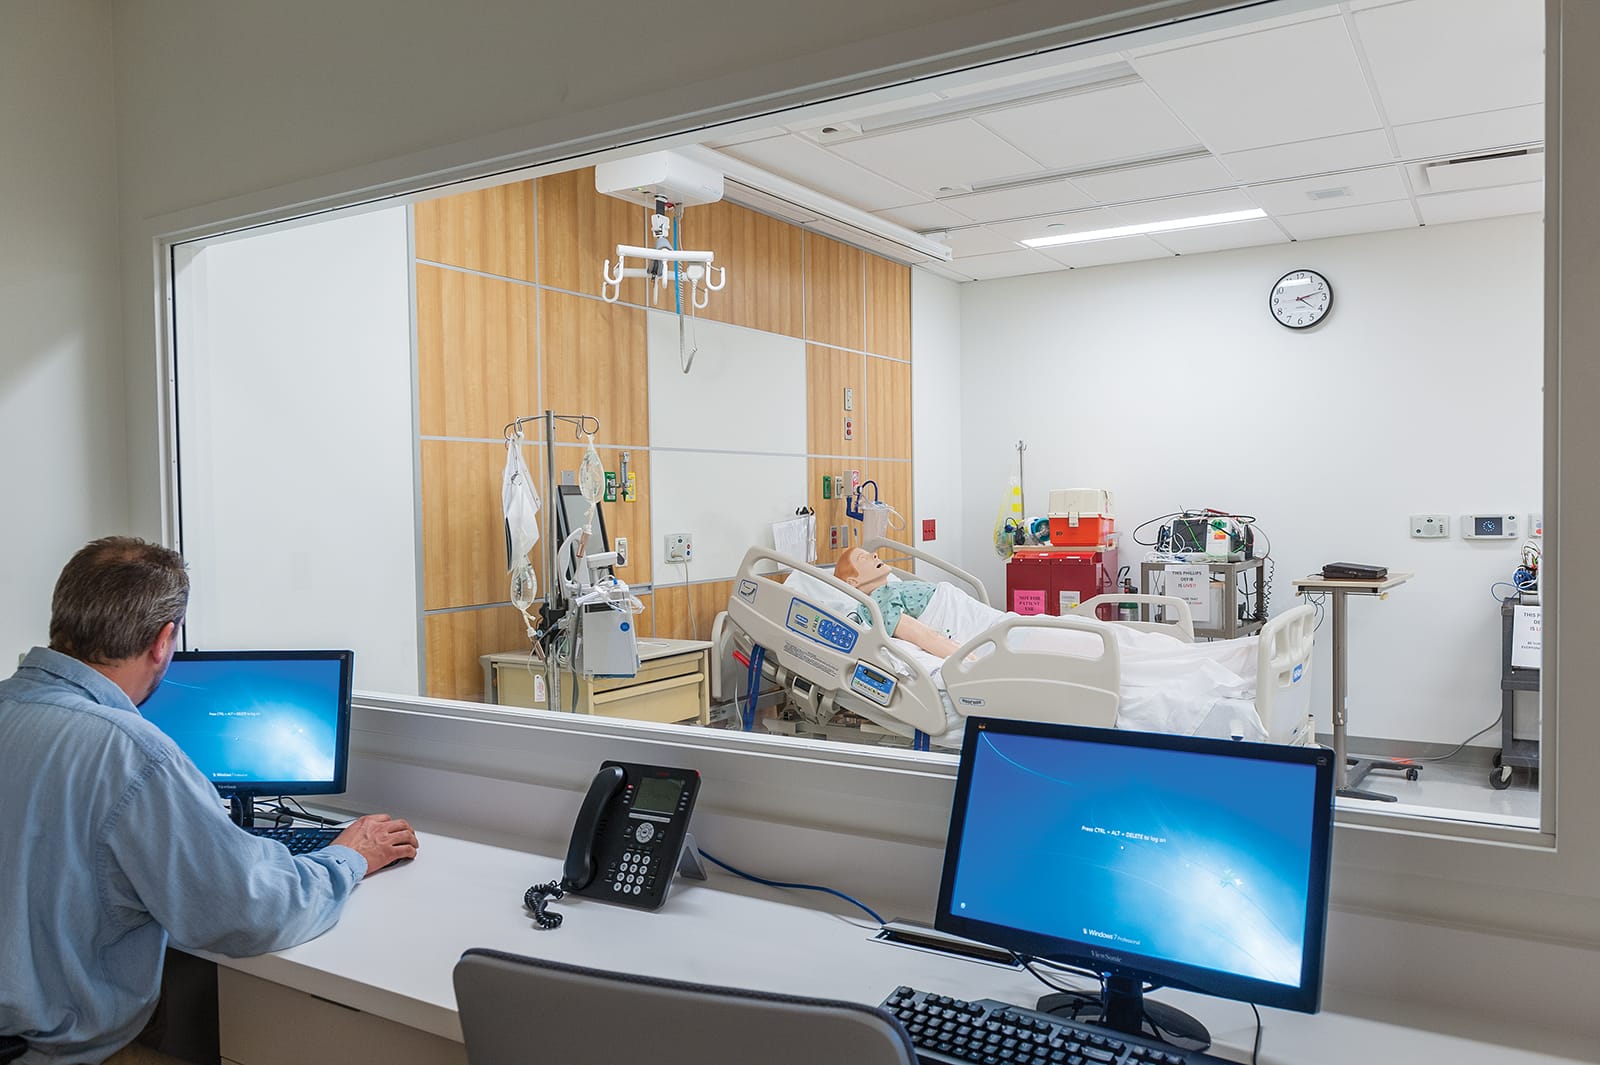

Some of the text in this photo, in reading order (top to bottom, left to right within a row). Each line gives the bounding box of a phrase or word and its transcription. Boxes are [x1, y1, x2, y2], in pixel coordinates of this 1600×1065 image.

[1125, 831, 1144, 840] DELETE
[1088, 929, 1113, 940] Windows
[1090, 950, 1122, 962] ViewSonic
